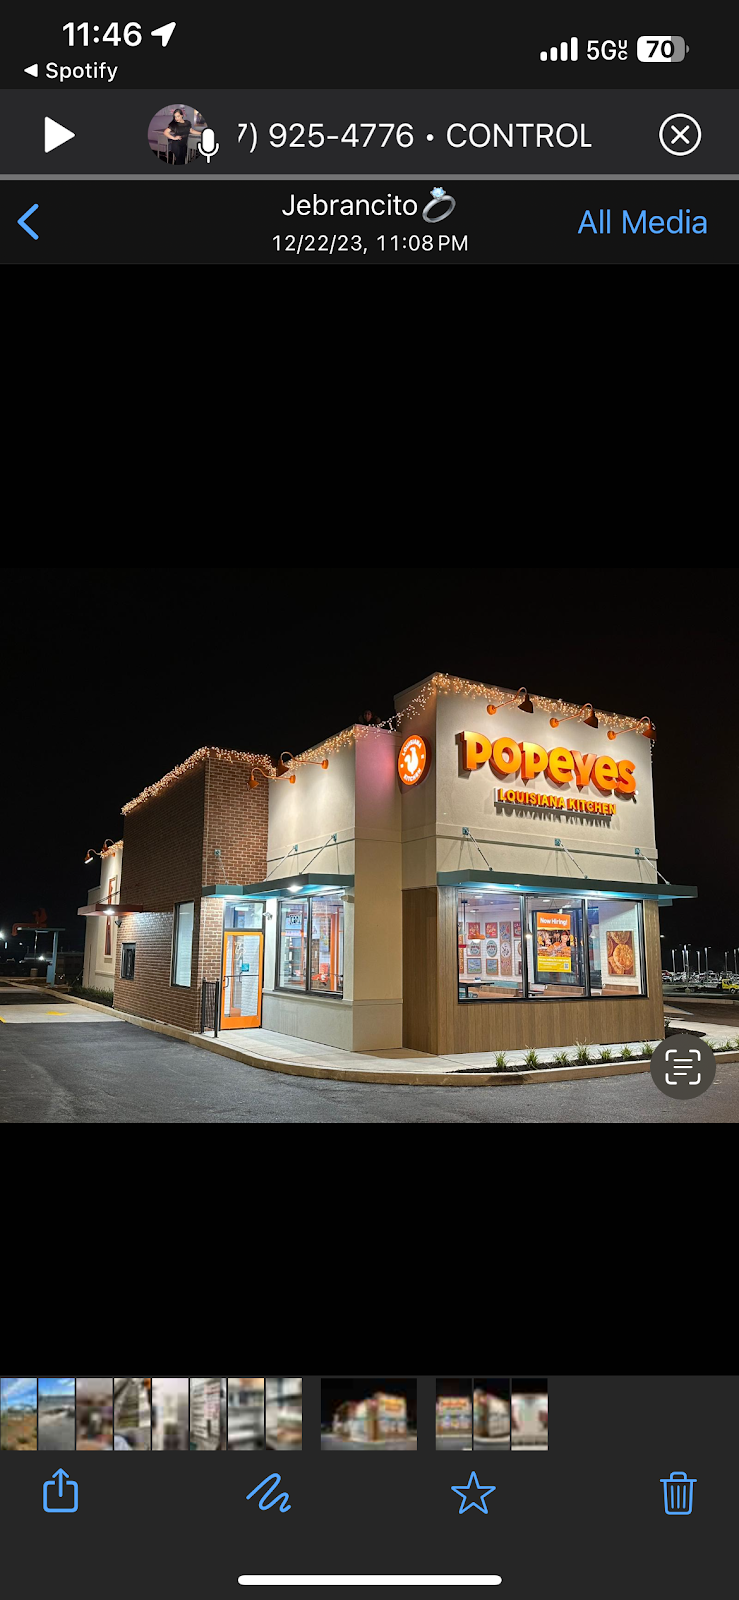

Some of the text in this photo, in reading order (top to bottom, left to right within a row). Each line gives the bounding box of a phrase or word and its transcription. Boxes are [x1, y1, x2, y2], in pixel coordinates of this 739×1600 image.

[498, 788, 617, 815] LOUISIANA KITCHEN
[552, 918, 568, 927] Hiring!
